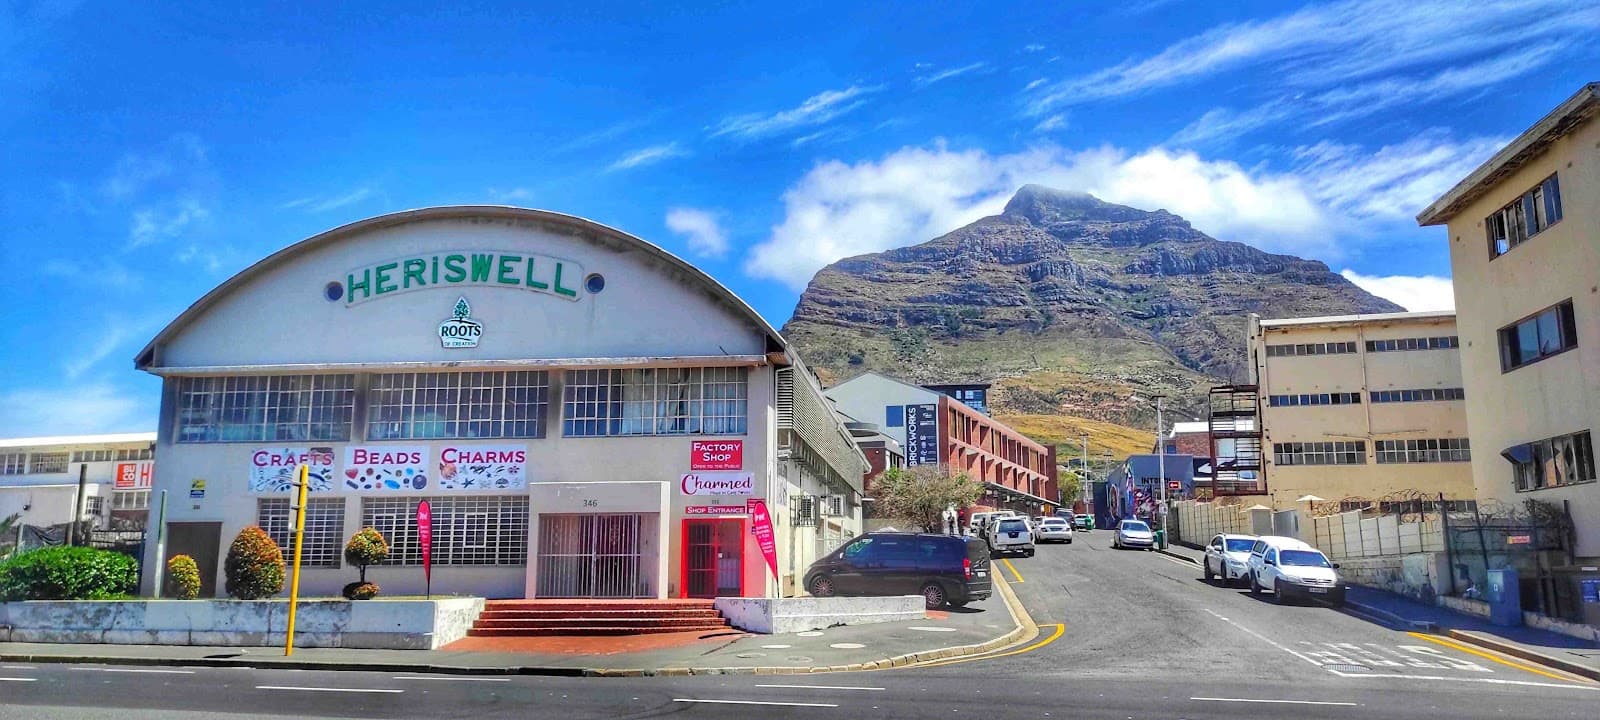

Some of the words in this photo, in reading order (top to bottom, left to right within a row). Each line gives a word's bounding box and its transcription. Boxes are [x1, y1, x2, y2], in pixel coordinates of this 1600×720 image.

[441, 325, 481, 337] ROOTS
[908, 407, 918, 467] BRICKWORKS
[441, 447, 526, 464] CHARMS
[693, 443, 740, 451] FACTORY
[253, 450, 333, 467] CRAFTS
[353, 448, 421, 465] BEADS
[703, 452, 731, 461] SHOP
[681, 474, 753, 495] Charmed
[583, 499, 598, 507] 346
